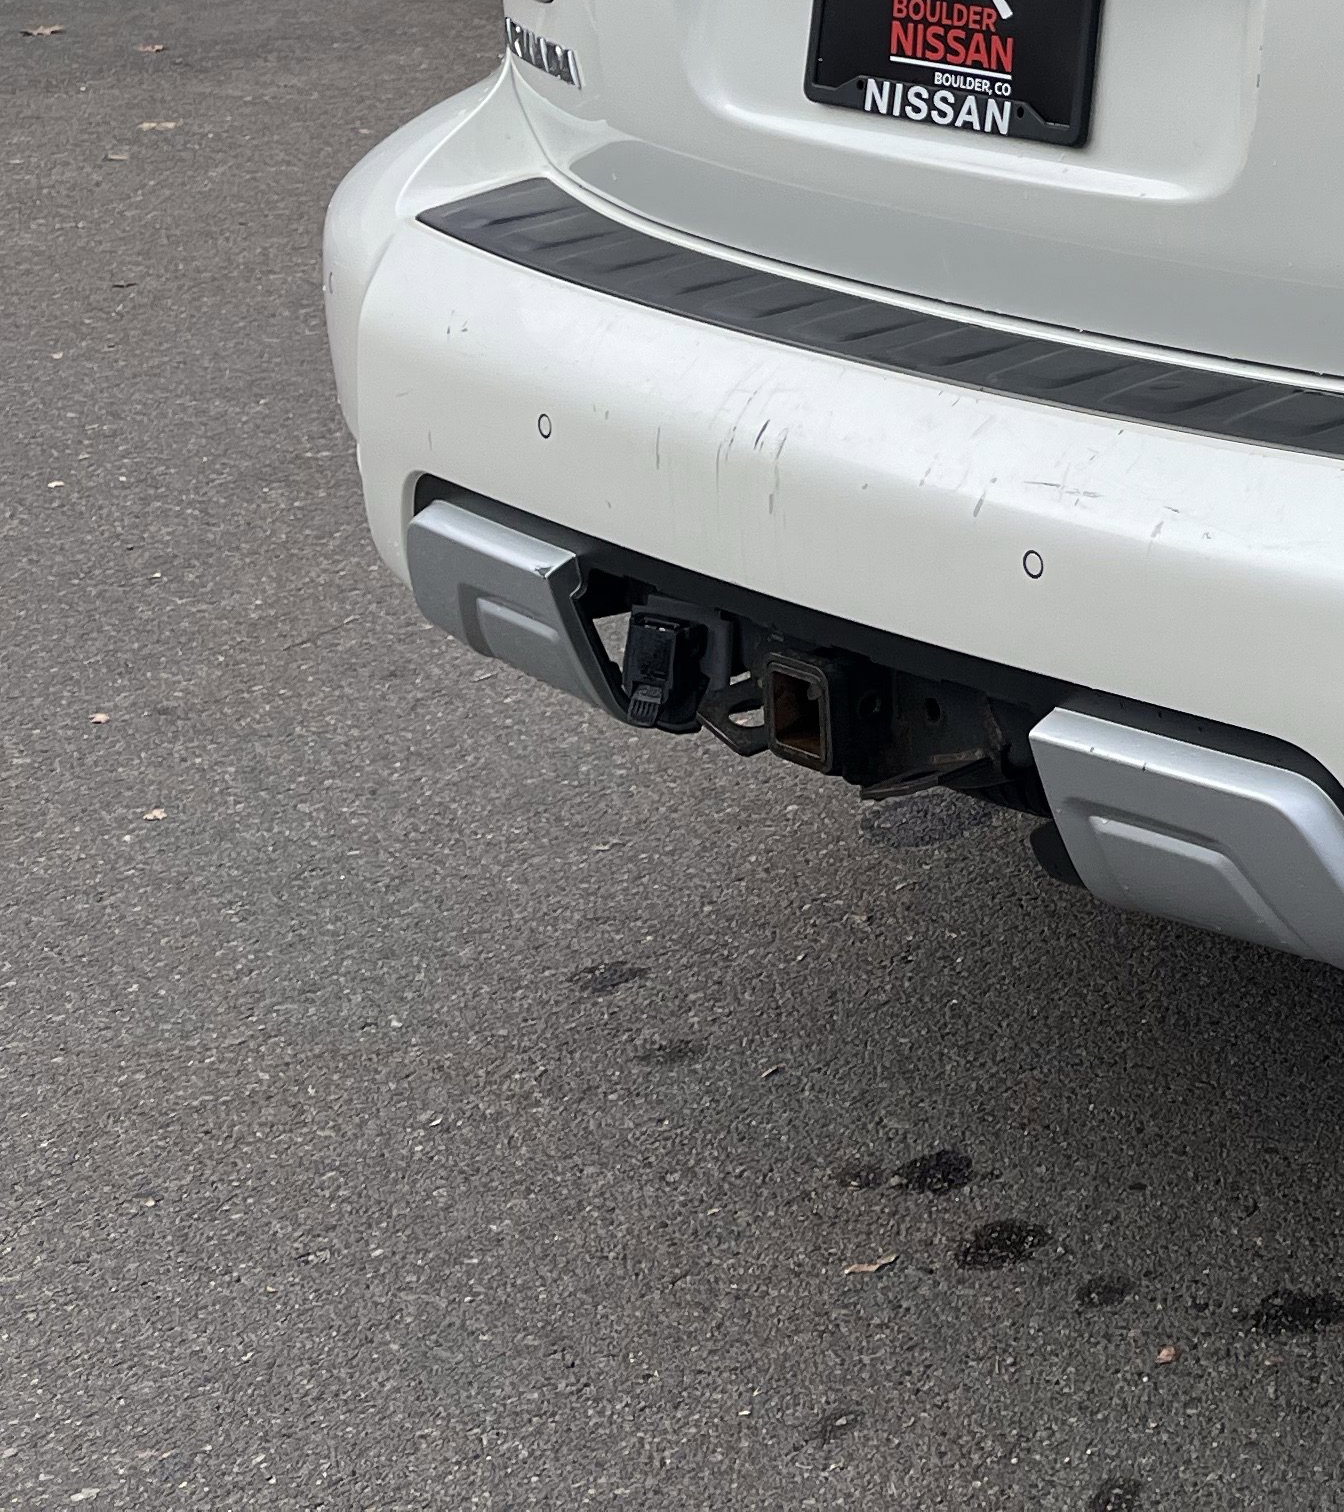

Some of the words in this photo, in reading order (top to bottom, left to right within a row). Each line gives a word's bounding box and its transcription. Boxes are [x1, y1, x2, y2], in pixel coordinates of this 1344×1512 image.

[890, 21, 1015, 73] NISSAN
[863, 78, 1012, 135] NISSAN
[934, 71, 993, 95] BOULDER,
[994, 80, 1012, 96] CO
